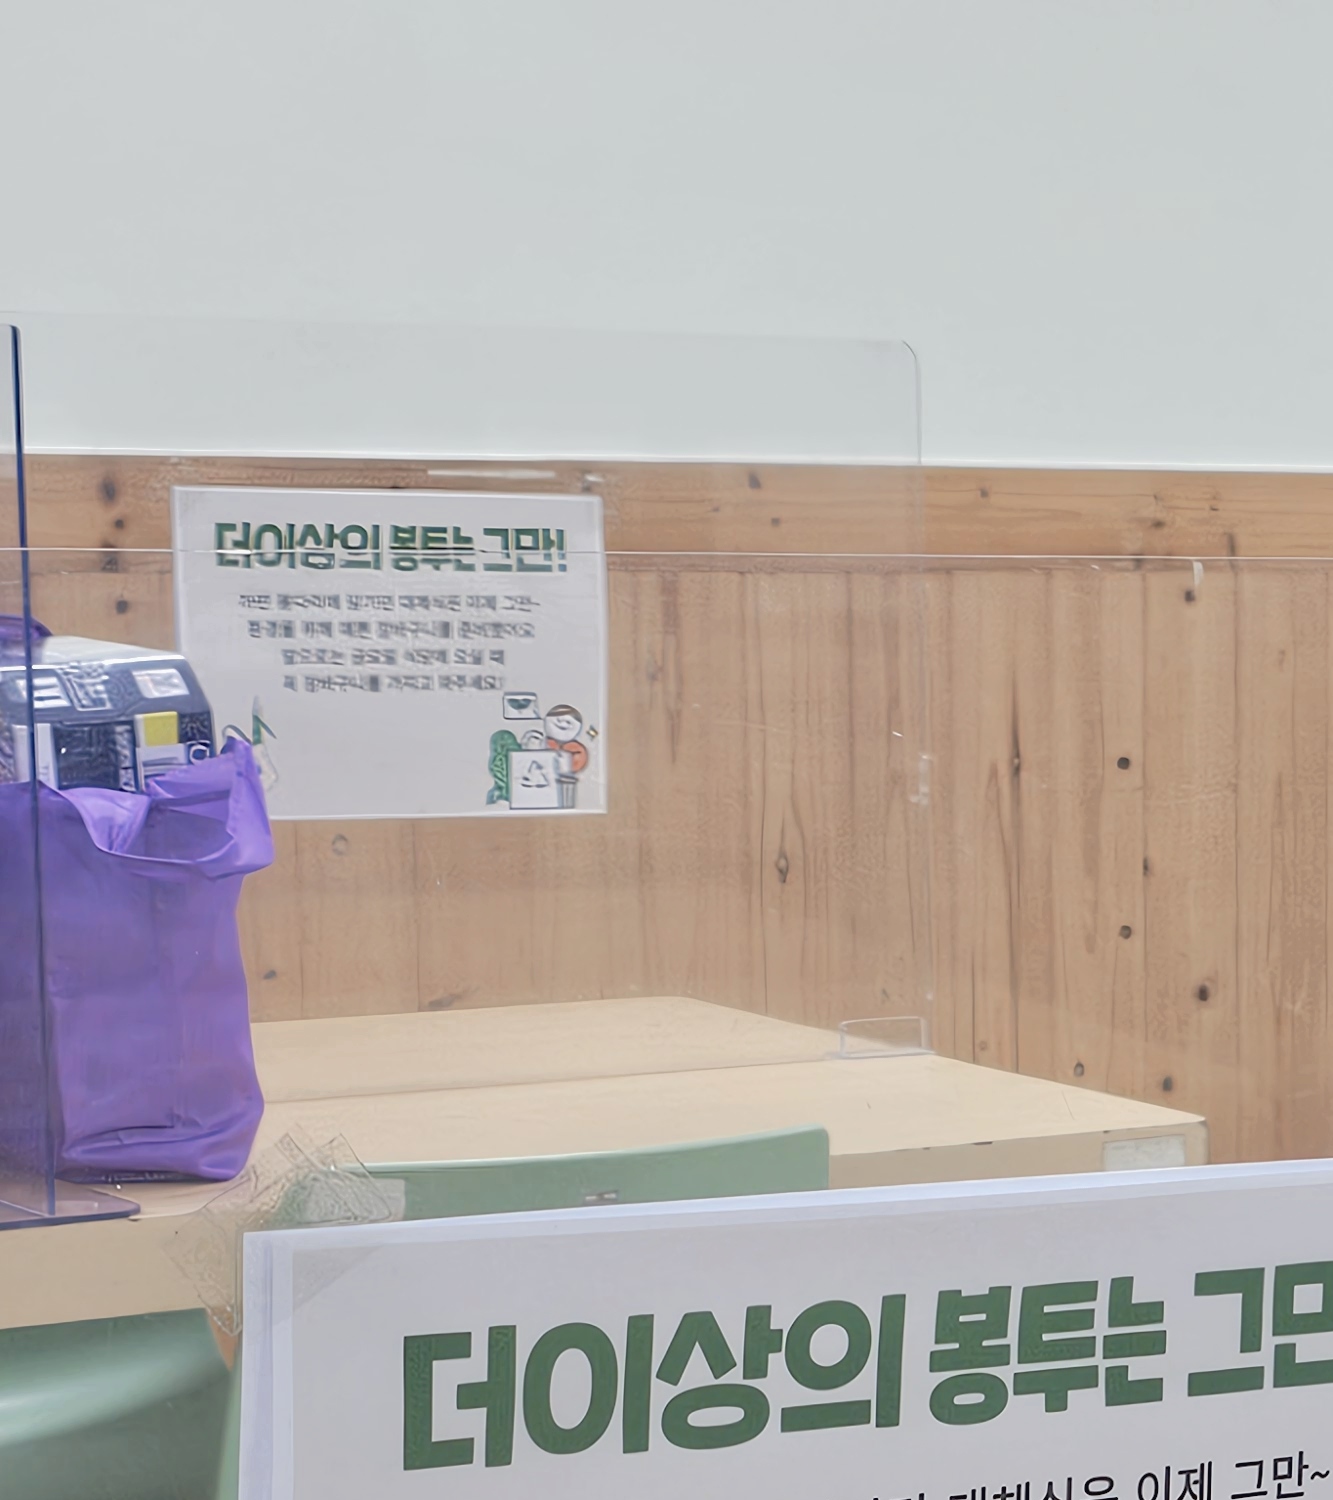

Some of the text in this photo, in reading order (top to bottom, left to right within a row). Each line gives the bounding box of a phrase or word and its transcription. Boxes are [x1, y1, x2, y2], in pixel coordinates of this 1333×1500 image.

[214, 521, 381, 571] 더이상의
[483, 527, 568, 573] 그만!
[405, 1295, 904, 1468] 더이상의
[929, 1278, 1165, 1423] 봉투는
[1230, 1450, 1331, 1500] 그만~
